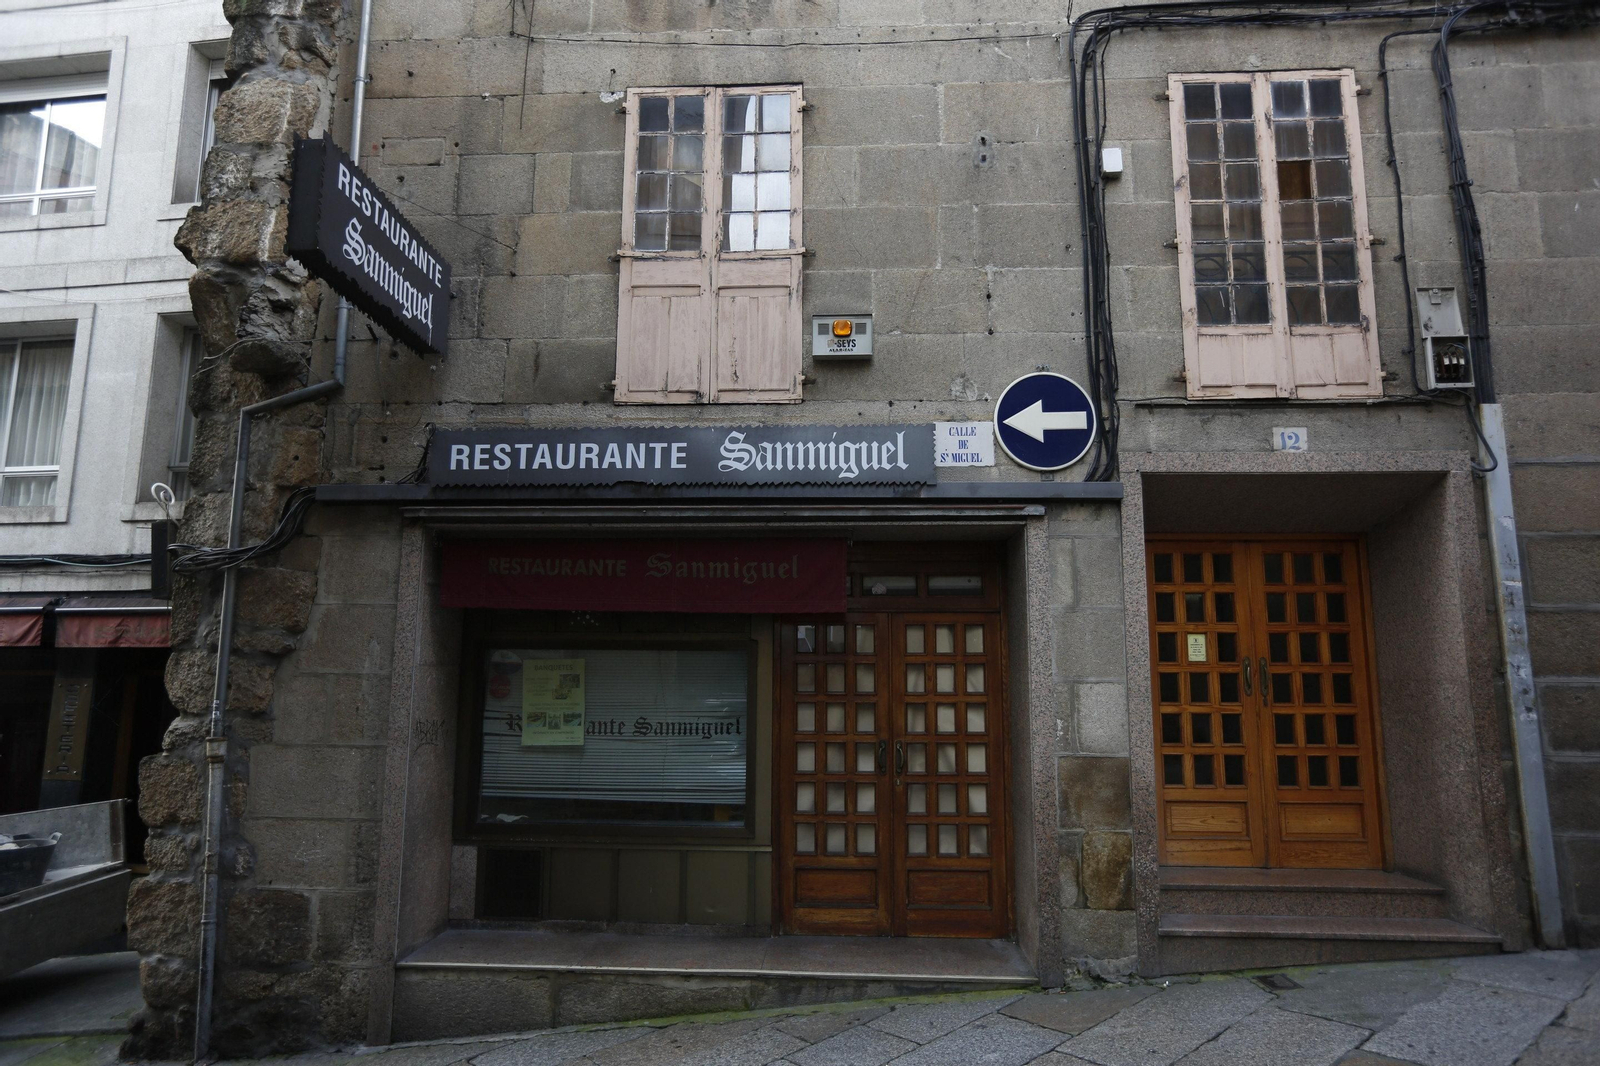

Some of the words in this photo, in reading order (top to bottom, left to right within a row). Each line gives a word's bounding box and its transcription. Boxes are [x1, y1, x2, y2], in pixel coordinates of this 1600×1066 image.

[337, 162, 443, 289] RESTAURANTE
[342, 217, 434, 331] Sanmiguel
[948, 426, 977, 437] CALLE
[1280, 431, 1302, 450] 12
[449, 442, 688, 471] RESTAURANTE
[717, 430, 910, 479] Sanmiguel
[958, 439, 969, 450] DE
[951, 452, 983, 463] MIGUEL
[487, 557, 627, 577] RESTAURANTE
[644, 552, 800, 584] Sanmiguel
[632, 716, 743, 740] Sanmiguel
